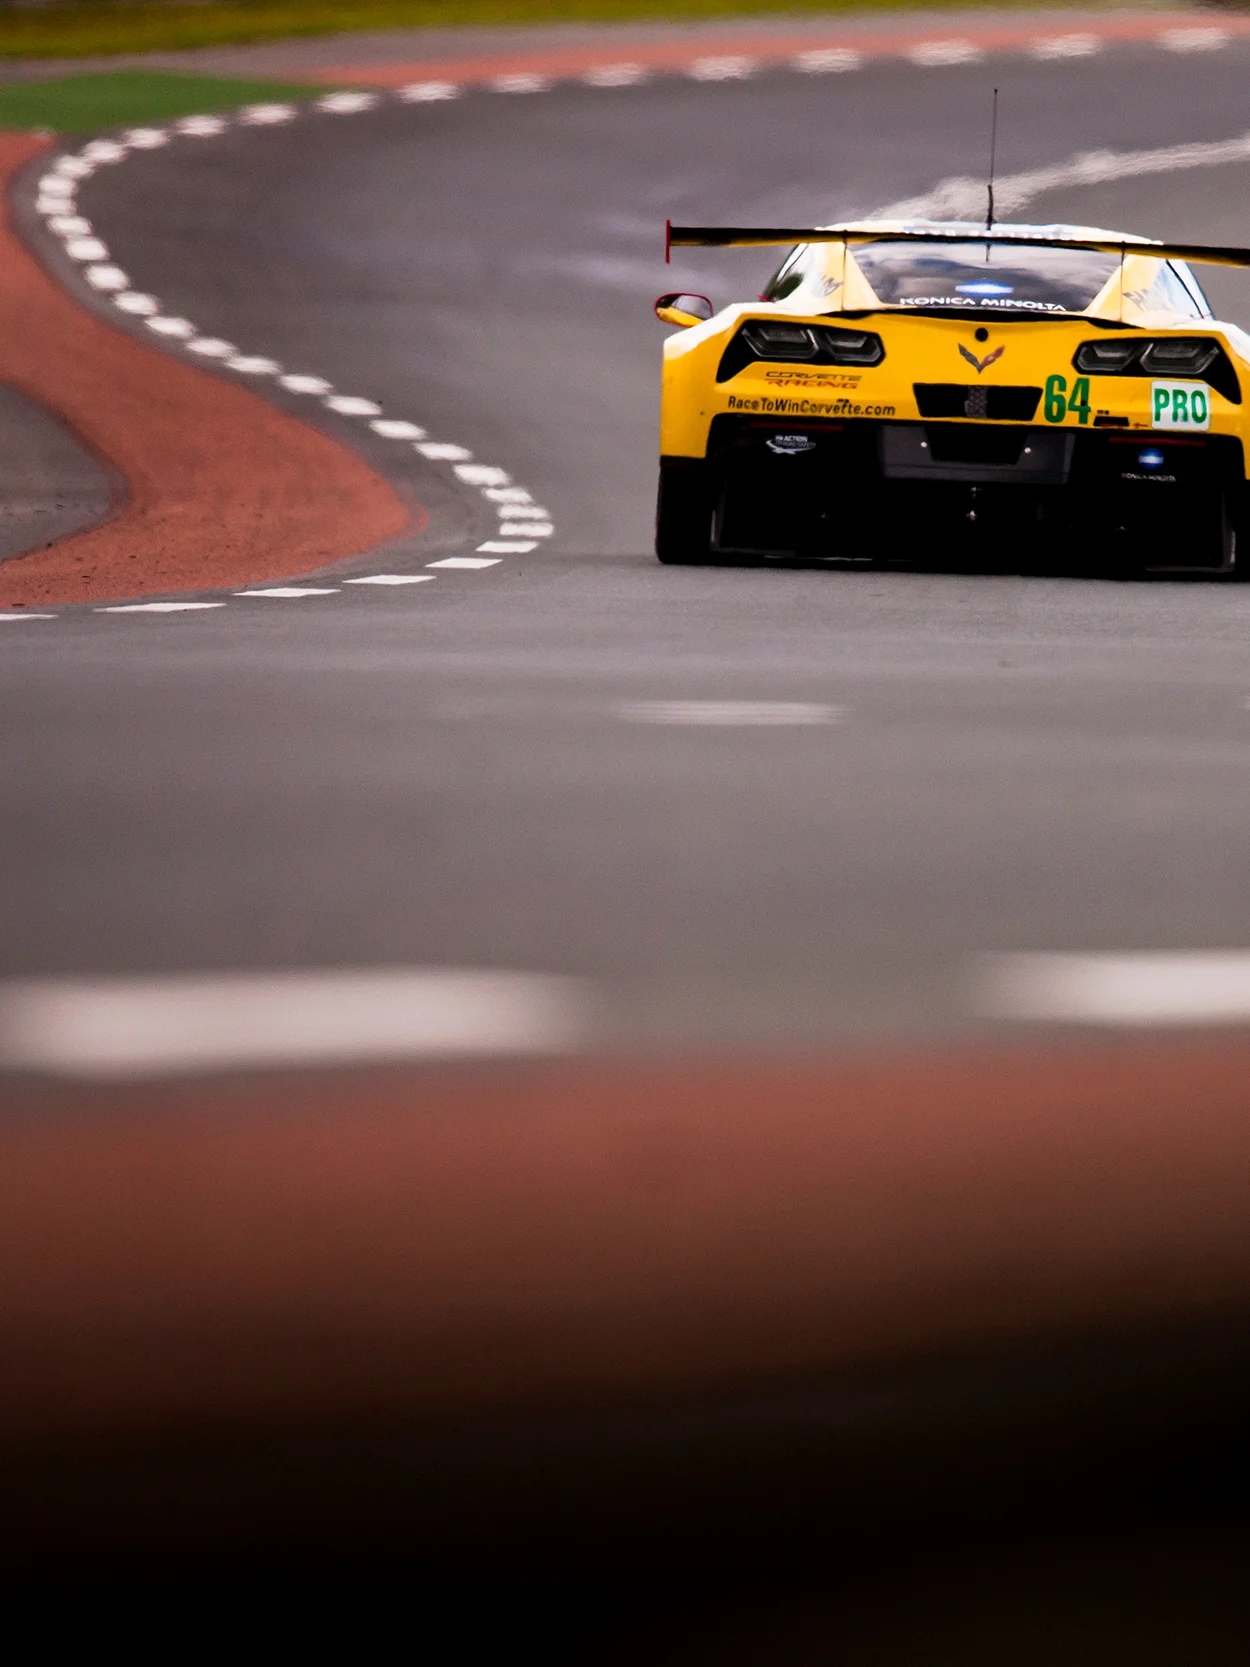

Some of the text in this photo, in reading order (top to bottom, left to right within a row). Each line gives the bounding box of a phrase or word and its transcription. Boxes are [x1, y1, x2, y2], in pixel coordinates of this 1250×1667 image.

[900, 297, 1067, 311] KONICA MINOLTA
[765, 371, 863, 382] CORVETTE
[765, 378, 858, 390] RACING
[1043, 374, 1092, 425] 64
[1153, 388, 1208, 424] PRO
